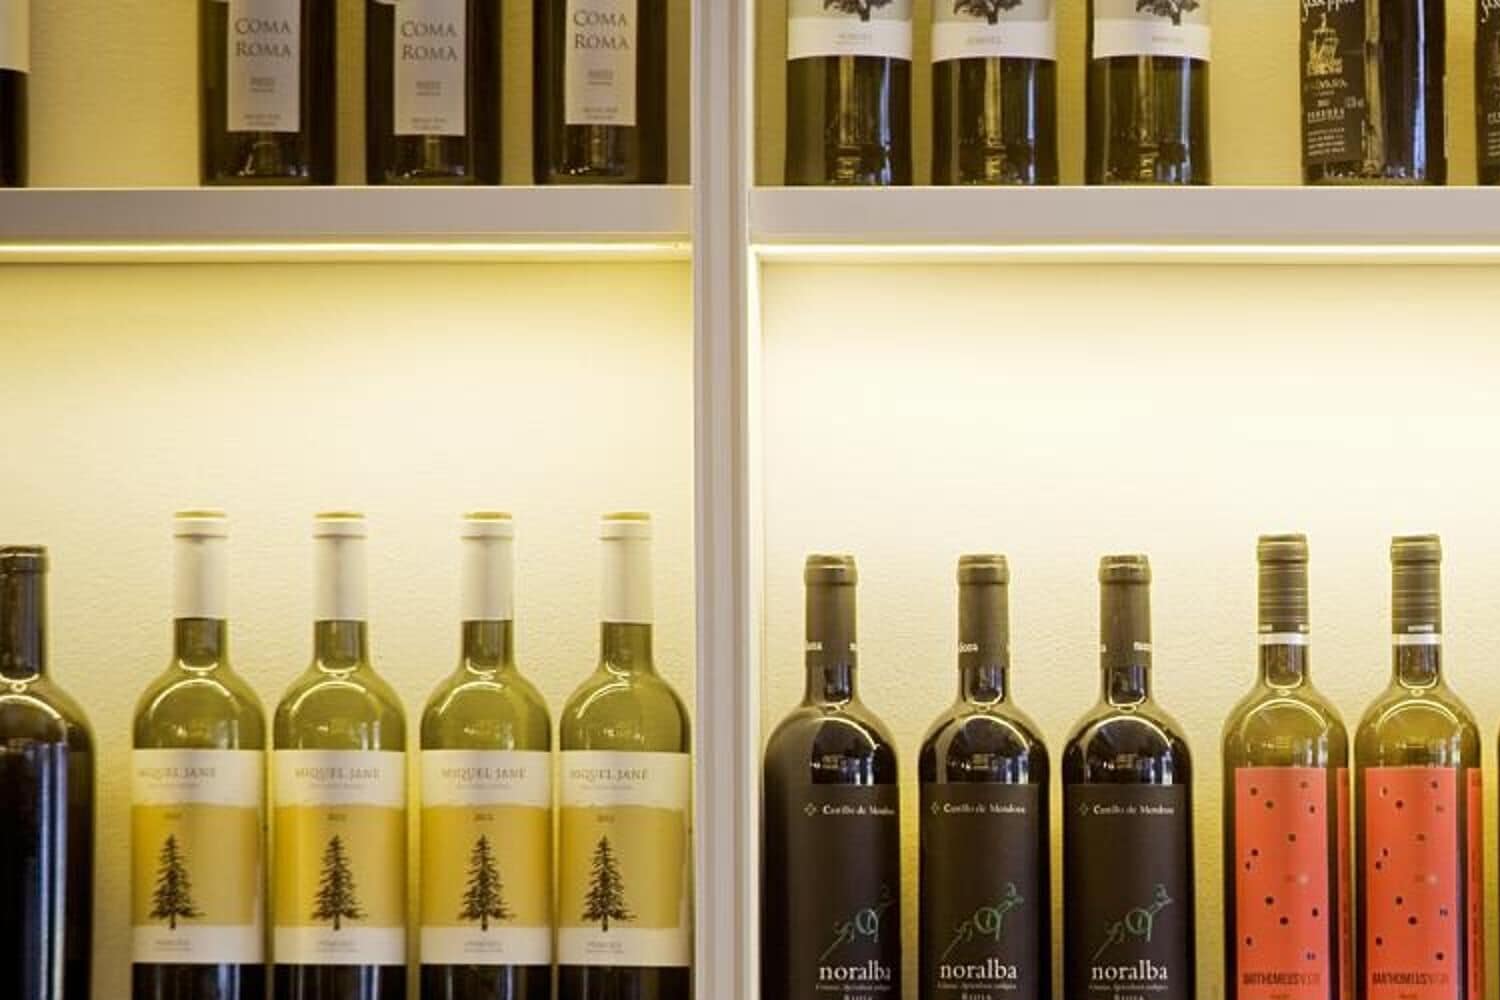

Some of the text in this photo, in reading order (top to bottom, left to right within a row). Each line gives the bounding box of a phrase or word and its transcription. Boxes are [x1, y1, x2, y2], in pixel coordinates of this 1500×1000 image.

[235, 17, 291, 35] COMA
[573, 9, 628, 27] COMA
[401, 20, 458, 38] COMA
[235, 41, 291, 58] ROMA
[574, 33, 632, 50] ROMA
[402, 43, 459, 62] ROMA
[819, 959, 892, 980] noralba
[940, 957, 1018, 979] noralba
[1091, 959, 1168, 980] noralba
